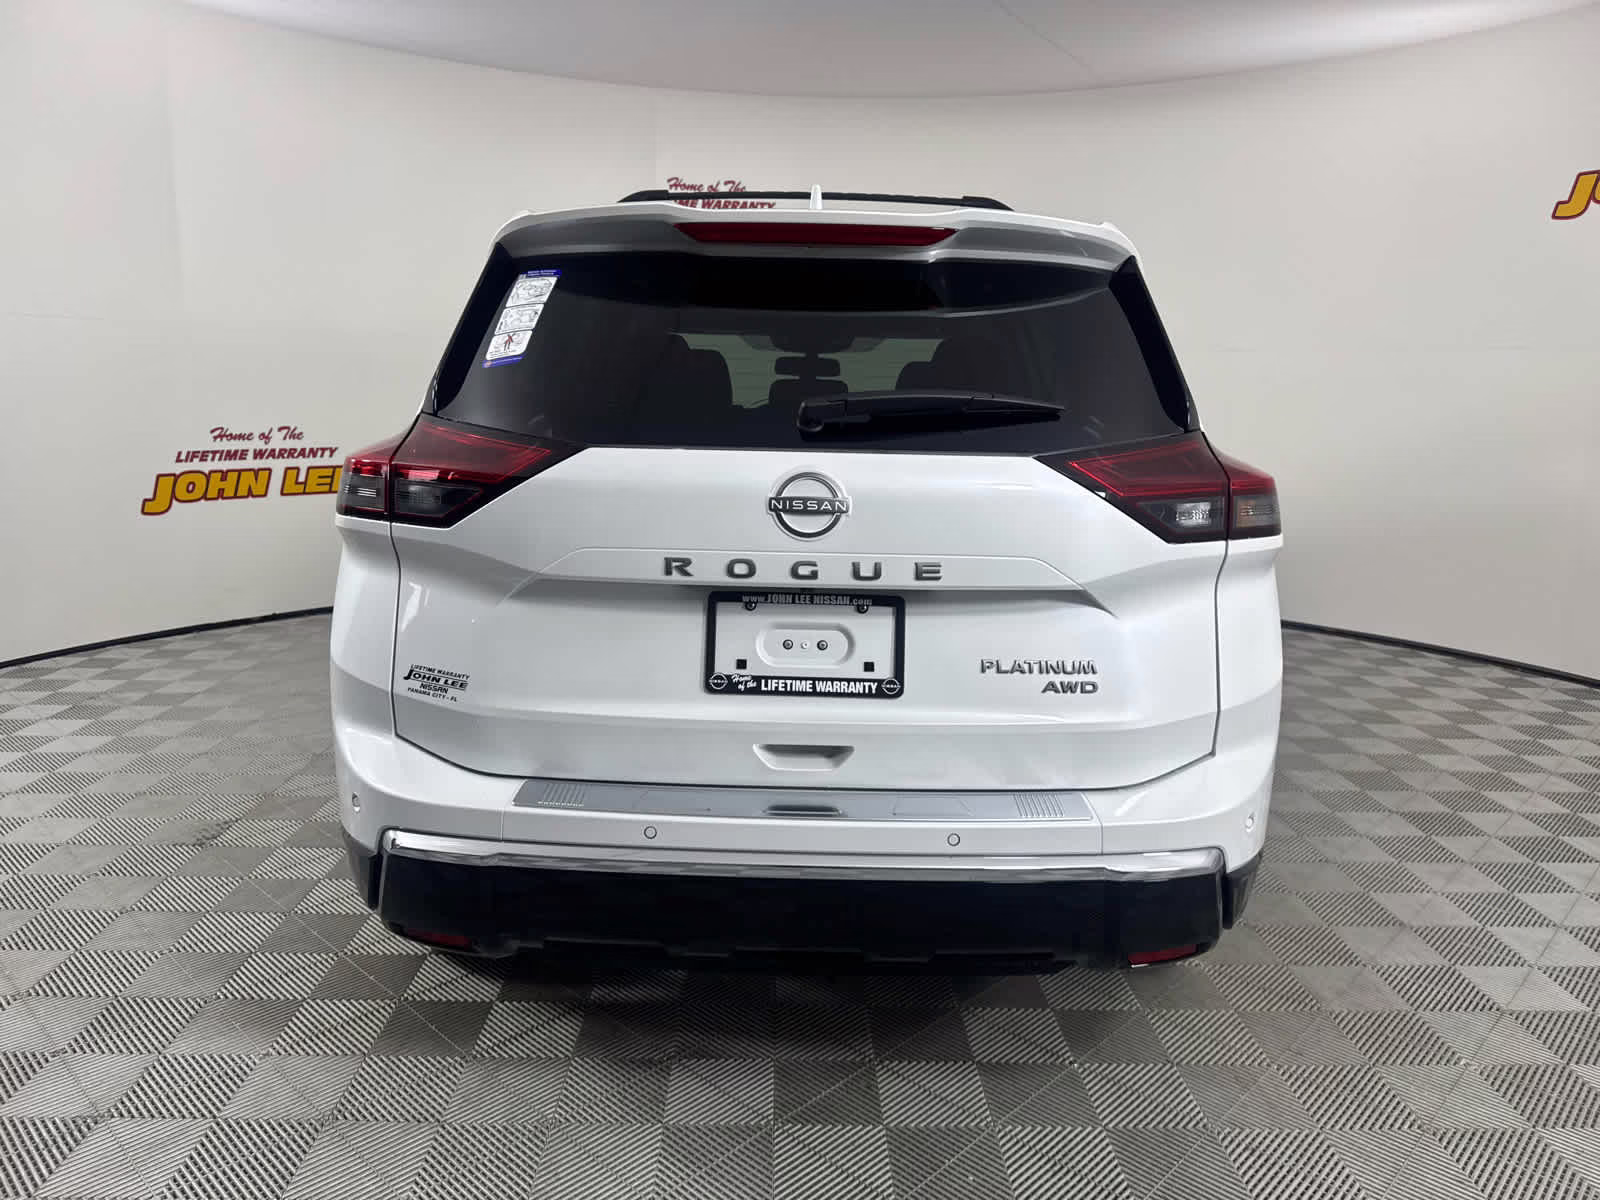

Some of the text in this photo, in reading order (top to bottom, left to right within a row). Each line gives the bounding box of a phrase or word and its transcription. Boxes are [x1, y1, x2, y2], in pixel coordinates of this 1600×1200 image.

[667, 177, 704, 192] Home
[724, 180, 746, 192] The
[701, 199, 777, 209] WARRANTY
[210, 425, 304, 445] Home of The
[175, 446, 338, 463] LIFETIME WARRANTY
[141, 467, 272, 515] JOHN
[770, 499, 848, 512] NISSAN
[663, 556, 944, 582] ROGUE
[795, 595, 812, 604] LEE
[980, 659, 1098, 675] PLATINUM
[403, 669, 469, 690] JOHN LEE
[761, 679, 878, 694] LIFETIME WARRANTY
[419, 682, 449, 694] NISSAN
[1041, 681, 1099, 694] AWD
